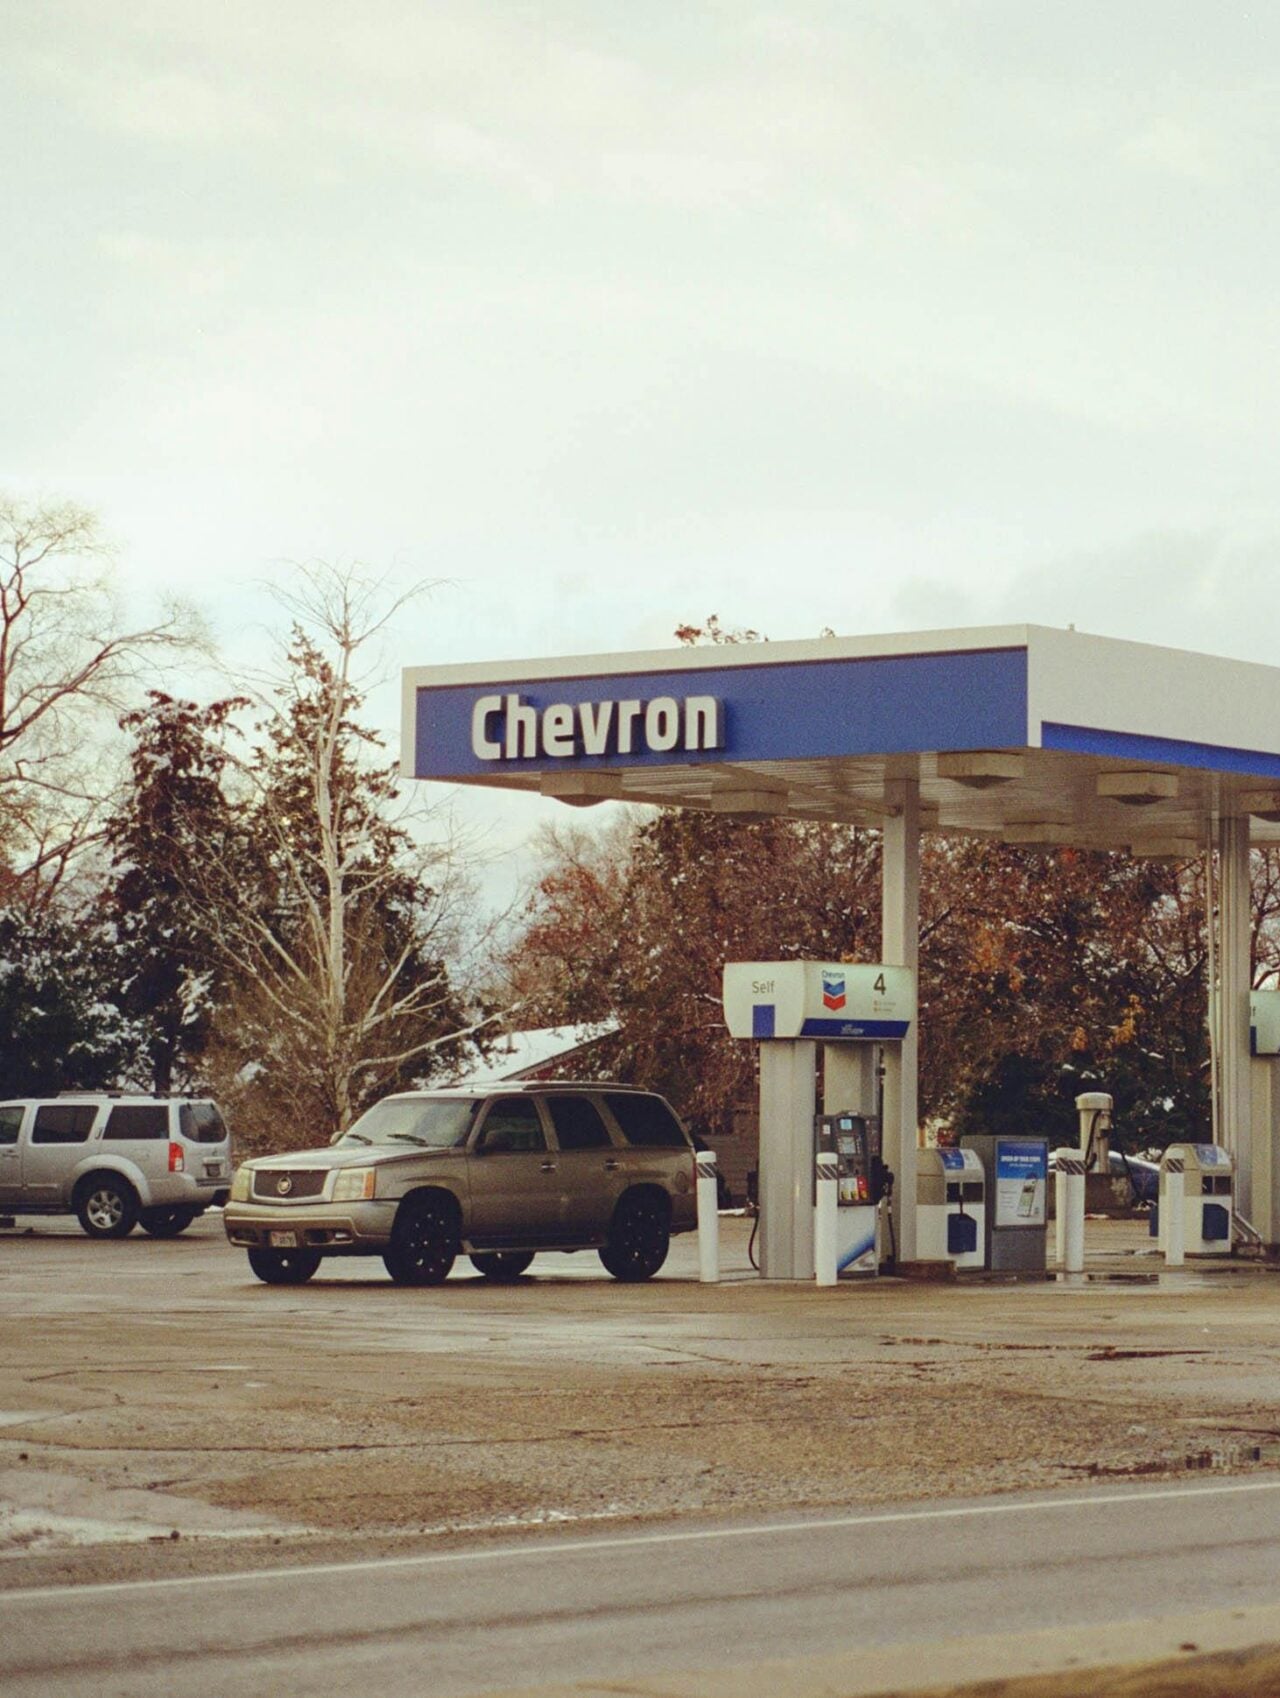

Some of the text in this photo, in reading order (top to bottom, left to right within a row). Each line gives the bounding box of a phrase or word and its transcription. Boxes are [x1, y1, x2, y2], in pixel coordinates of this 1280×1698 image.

[471, 693, 721, 762] Chevron
[752, 981, 775, 994] Self
[873, 973, 887, 995] 4
